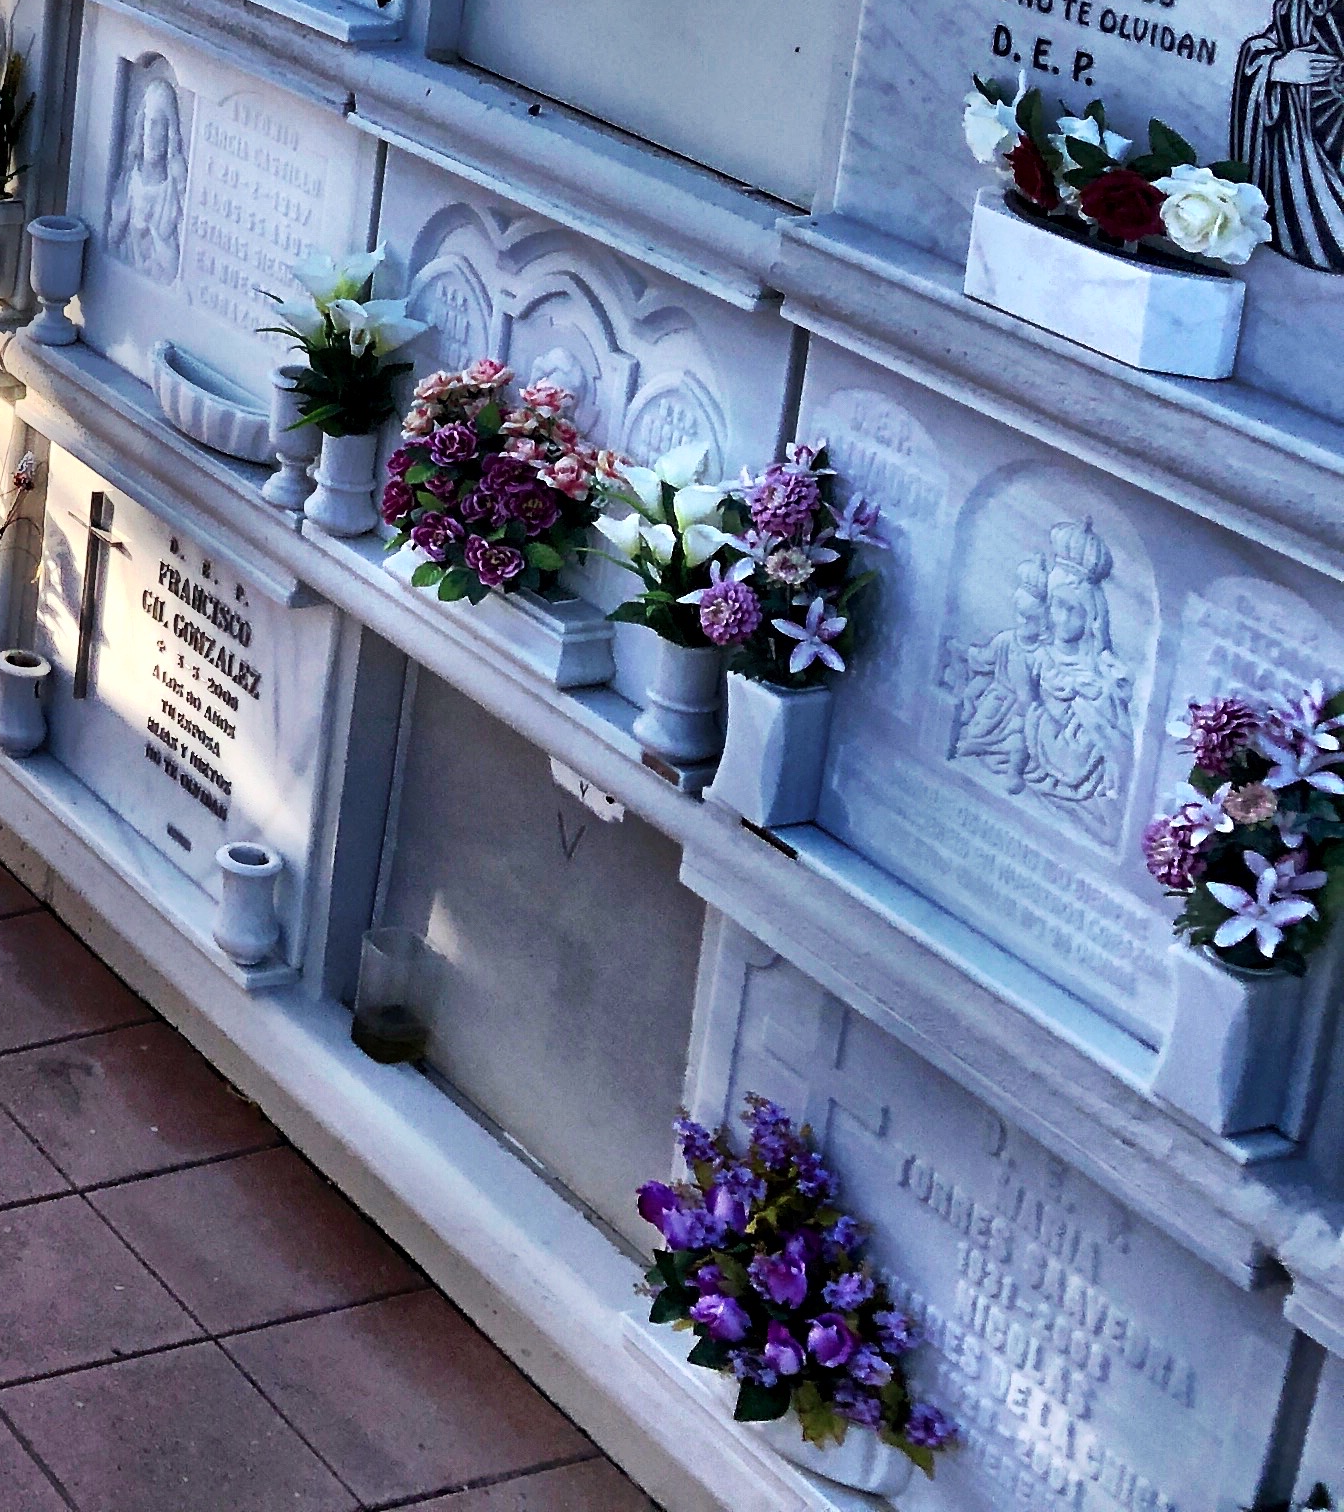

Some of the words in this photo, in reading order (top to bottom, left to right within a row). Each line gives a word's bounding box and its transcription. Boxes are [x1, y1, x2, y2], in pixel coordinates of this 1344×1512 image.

[991, 24, 1022, 64] D.
[1031, 38, 1061, 77] E.
[1073, 50, 1096, 87] P.
[1098, 8, 1219, 67] OLVIDAN
[159, 559, 252, 648] FRANCISCO
[142, 589, 168, 628] GIL
[173, 613, 262, 700] GONZALEZ
[177, 711, 221, 759] ESPOSA
[181, 743, 189, 758] Y
[190, 751, 232, 796] NIETOS
